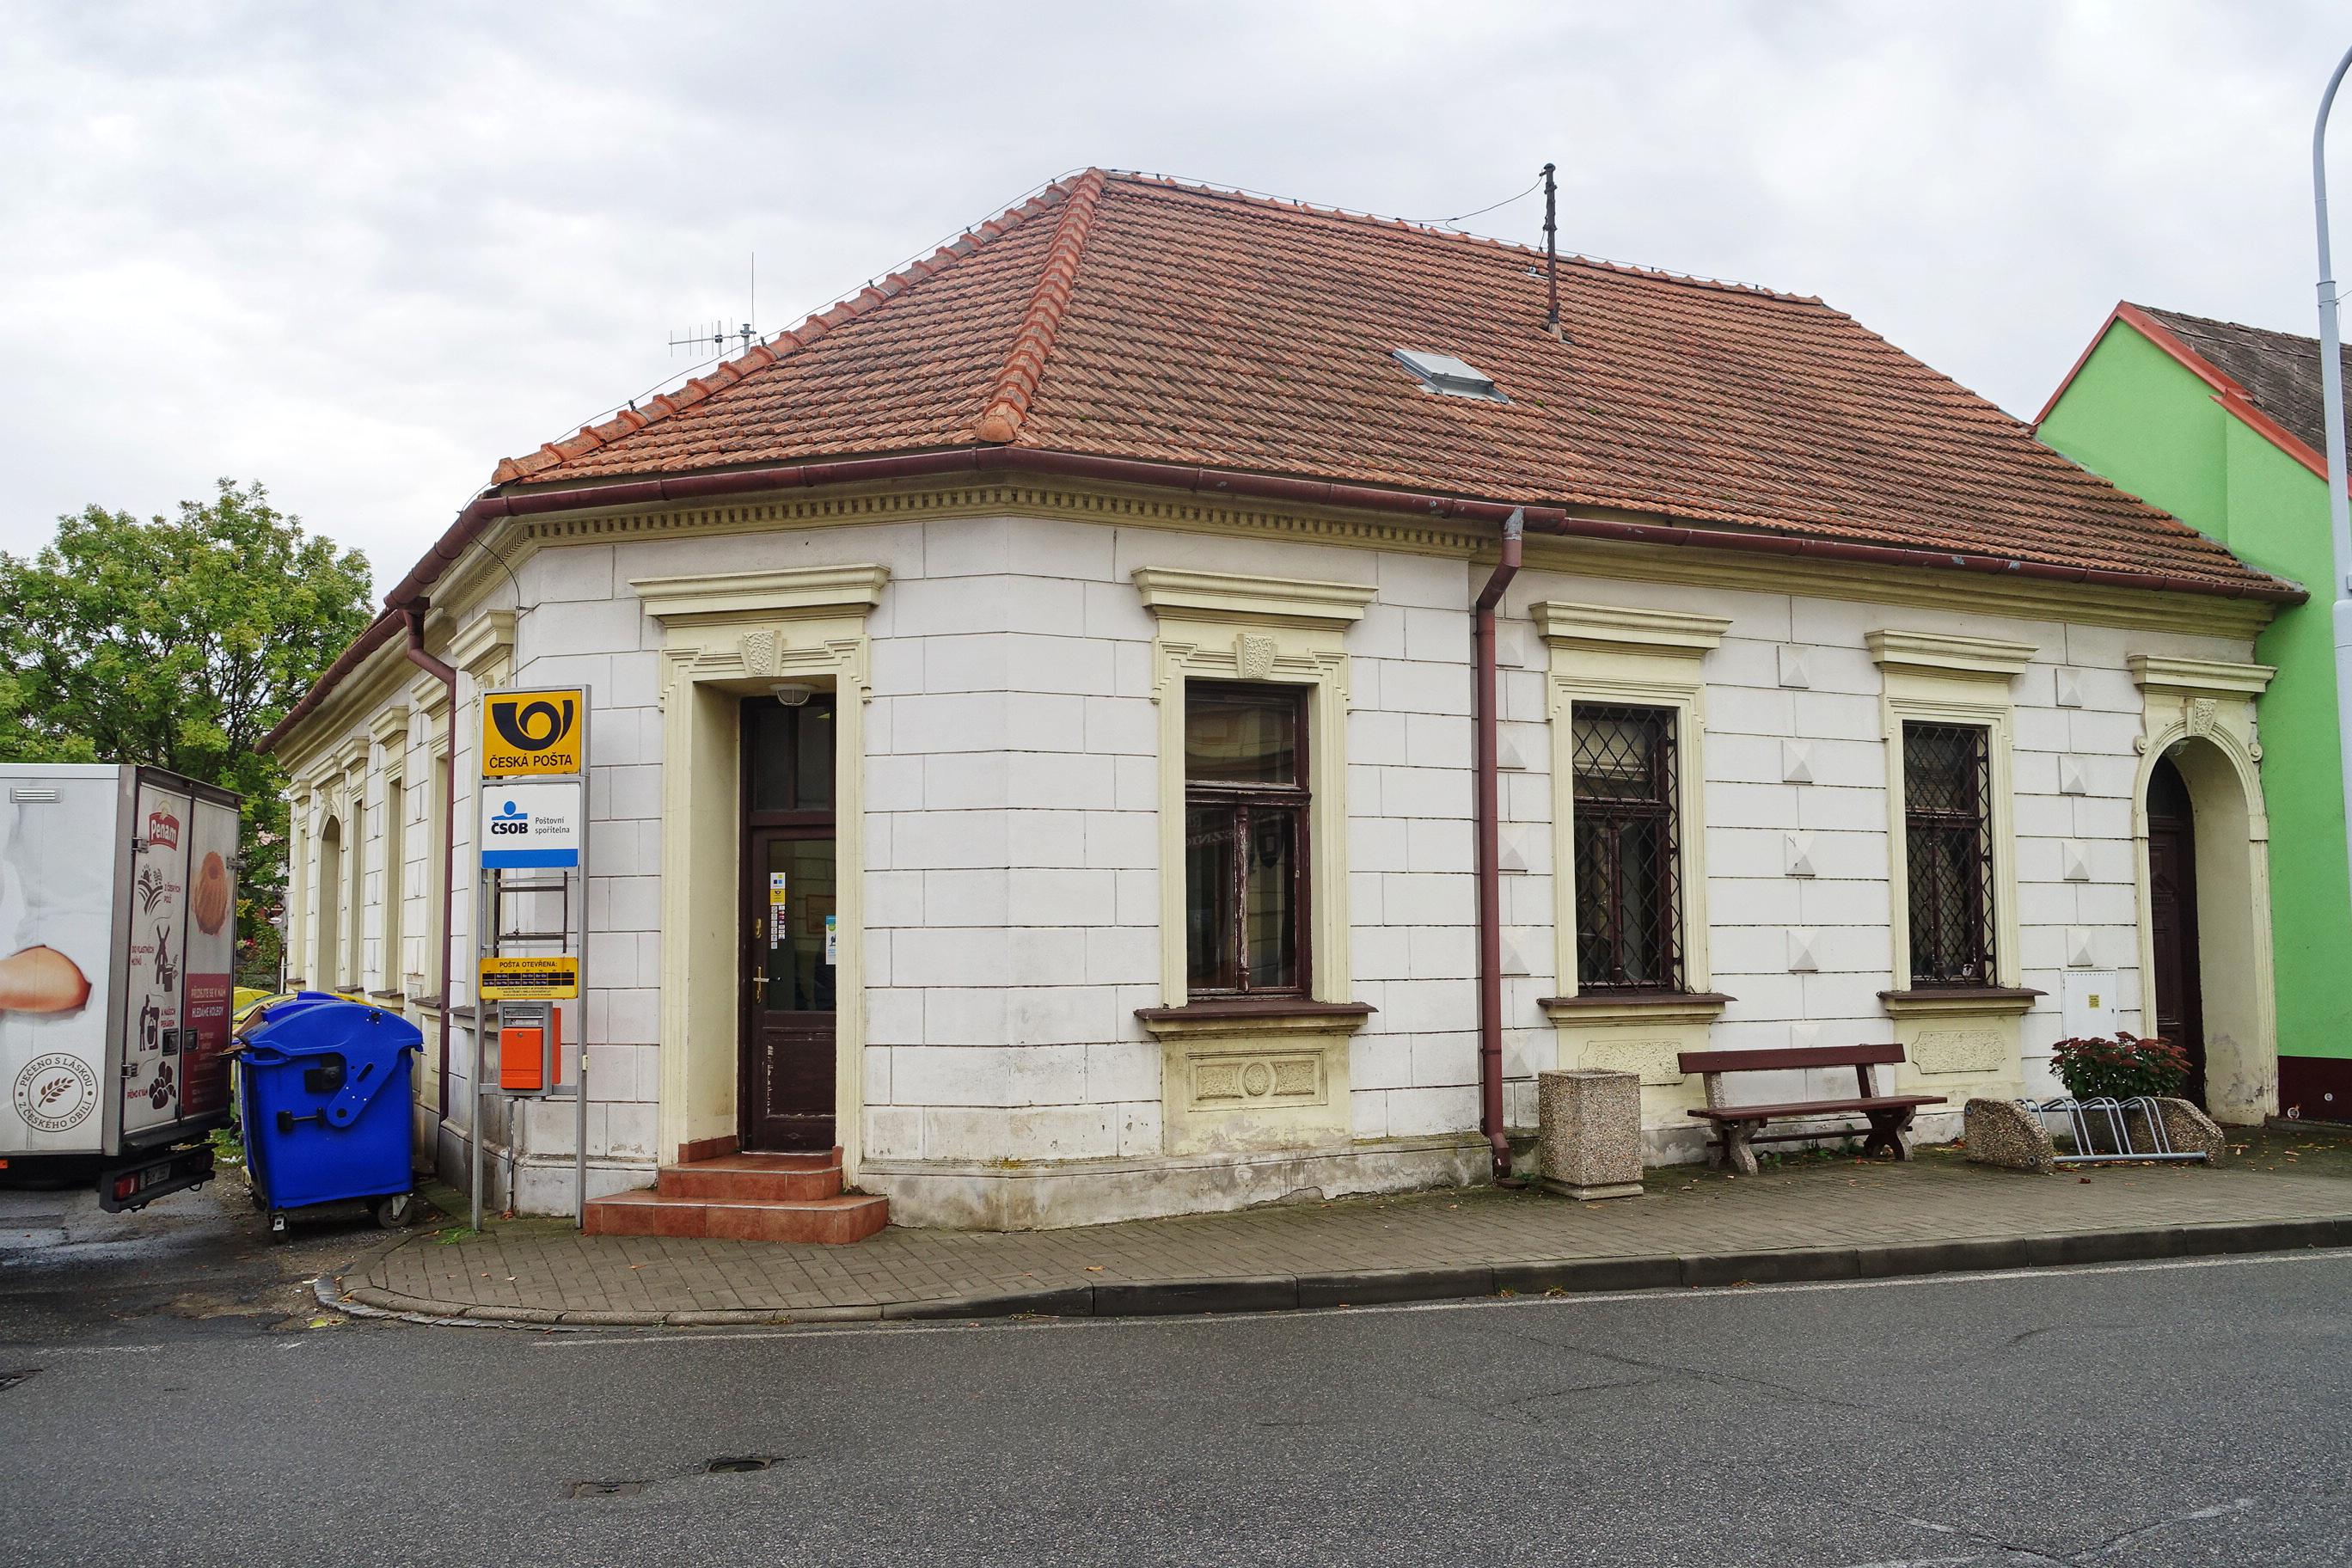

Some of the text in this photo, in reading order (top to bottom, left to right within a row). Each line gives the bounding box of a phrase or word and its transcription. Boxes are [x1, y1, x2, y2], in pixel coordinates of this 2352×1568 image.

[489, 751, 573, 769] ČESKÁ POŠTA
[491, 821, 529, 835] ČSOB
[535, 816, 565, 824] Poštovní
[151, 819, 177, 844] Penam
[535, 825, 570, 836] spořitelna
[20, 1057, 93, 1087] PEČENO S LÁSKOU
[22, 1108, 67, 1129] ČESKÉHO
[70, 1100, 92, 1124] OBILÍ
